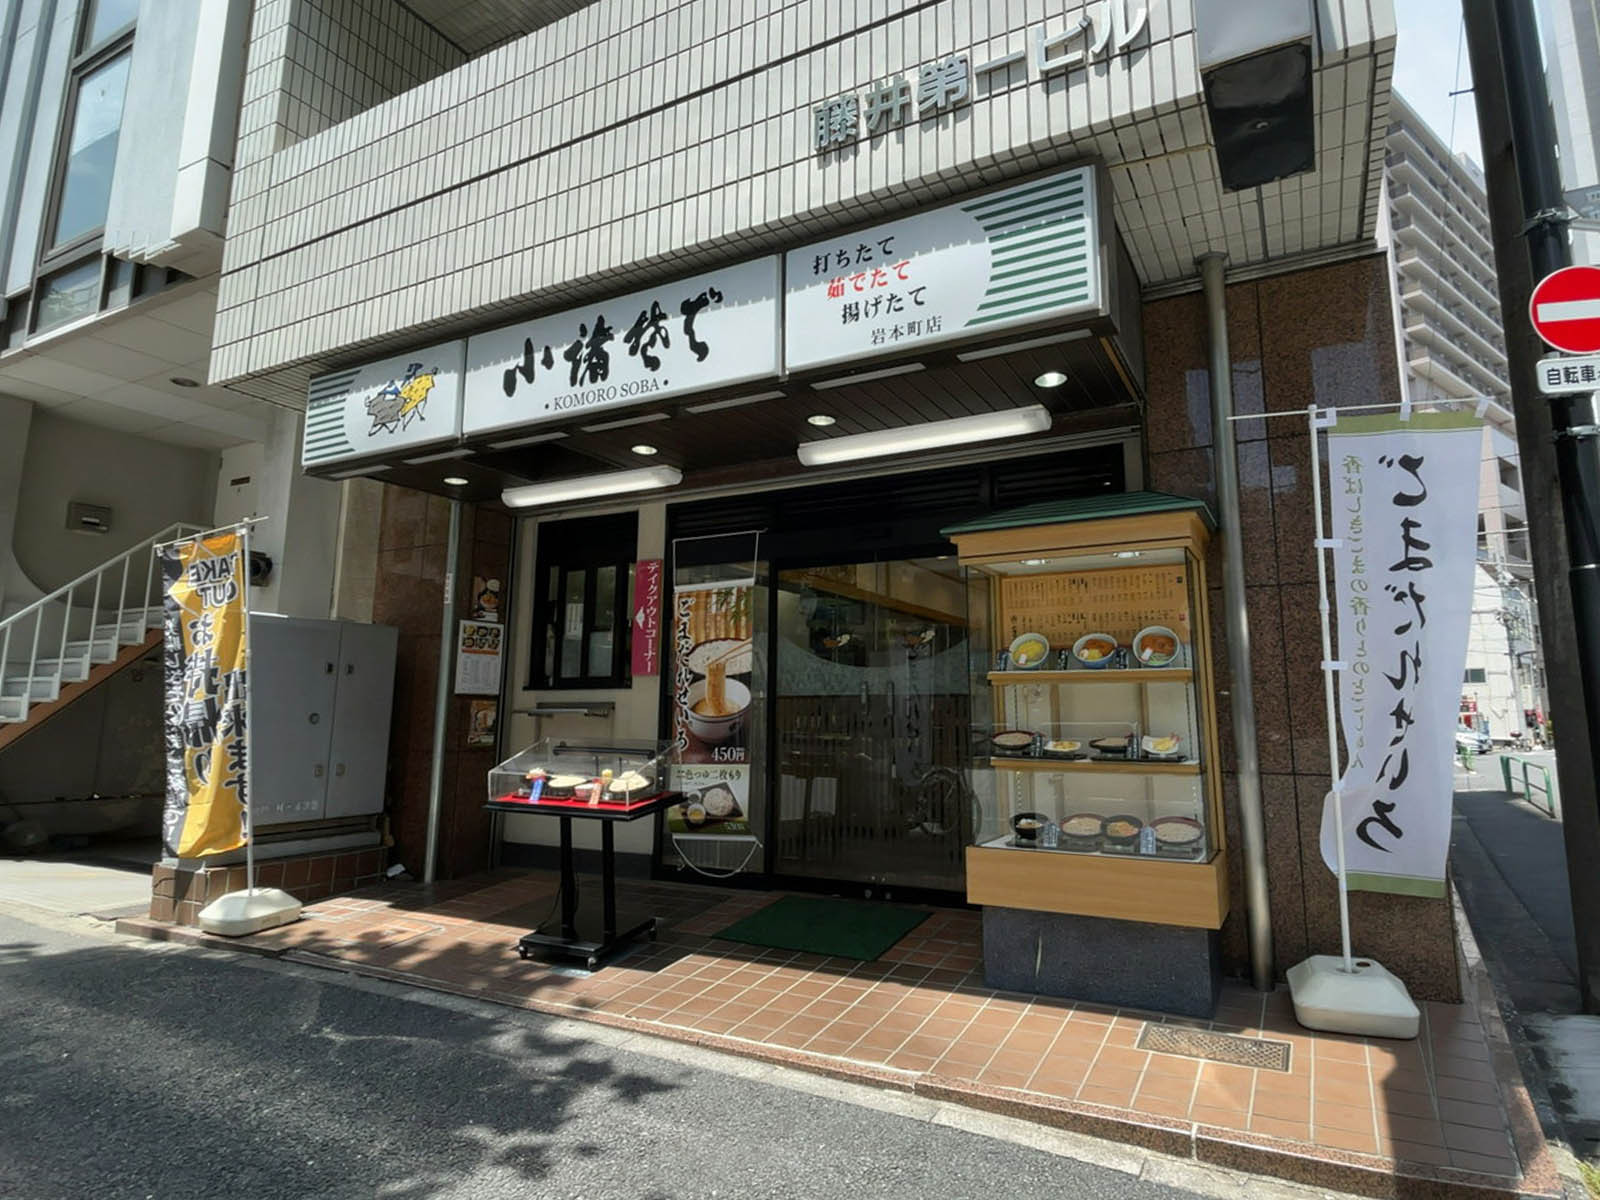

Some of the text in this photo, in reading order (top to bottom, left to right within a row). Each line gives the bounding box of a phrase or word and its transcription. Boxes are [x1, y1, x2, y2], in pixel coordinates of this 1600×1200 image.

[812, 0, 1148, 149] 藤井第一ビル
[813, 236, 895, 275] 打ちたて
[827, 260, 911, 299] 茹でたて
[841, 286, 927, 325] 揚げたて
[870, 315, 942, 345] 岩本町店
[554, 378, 659, 411] KOMORO SOBA
[1547, 365, 1600, 386] 自転車
[643, 562, 659, 673] テイクアウトコーナー
